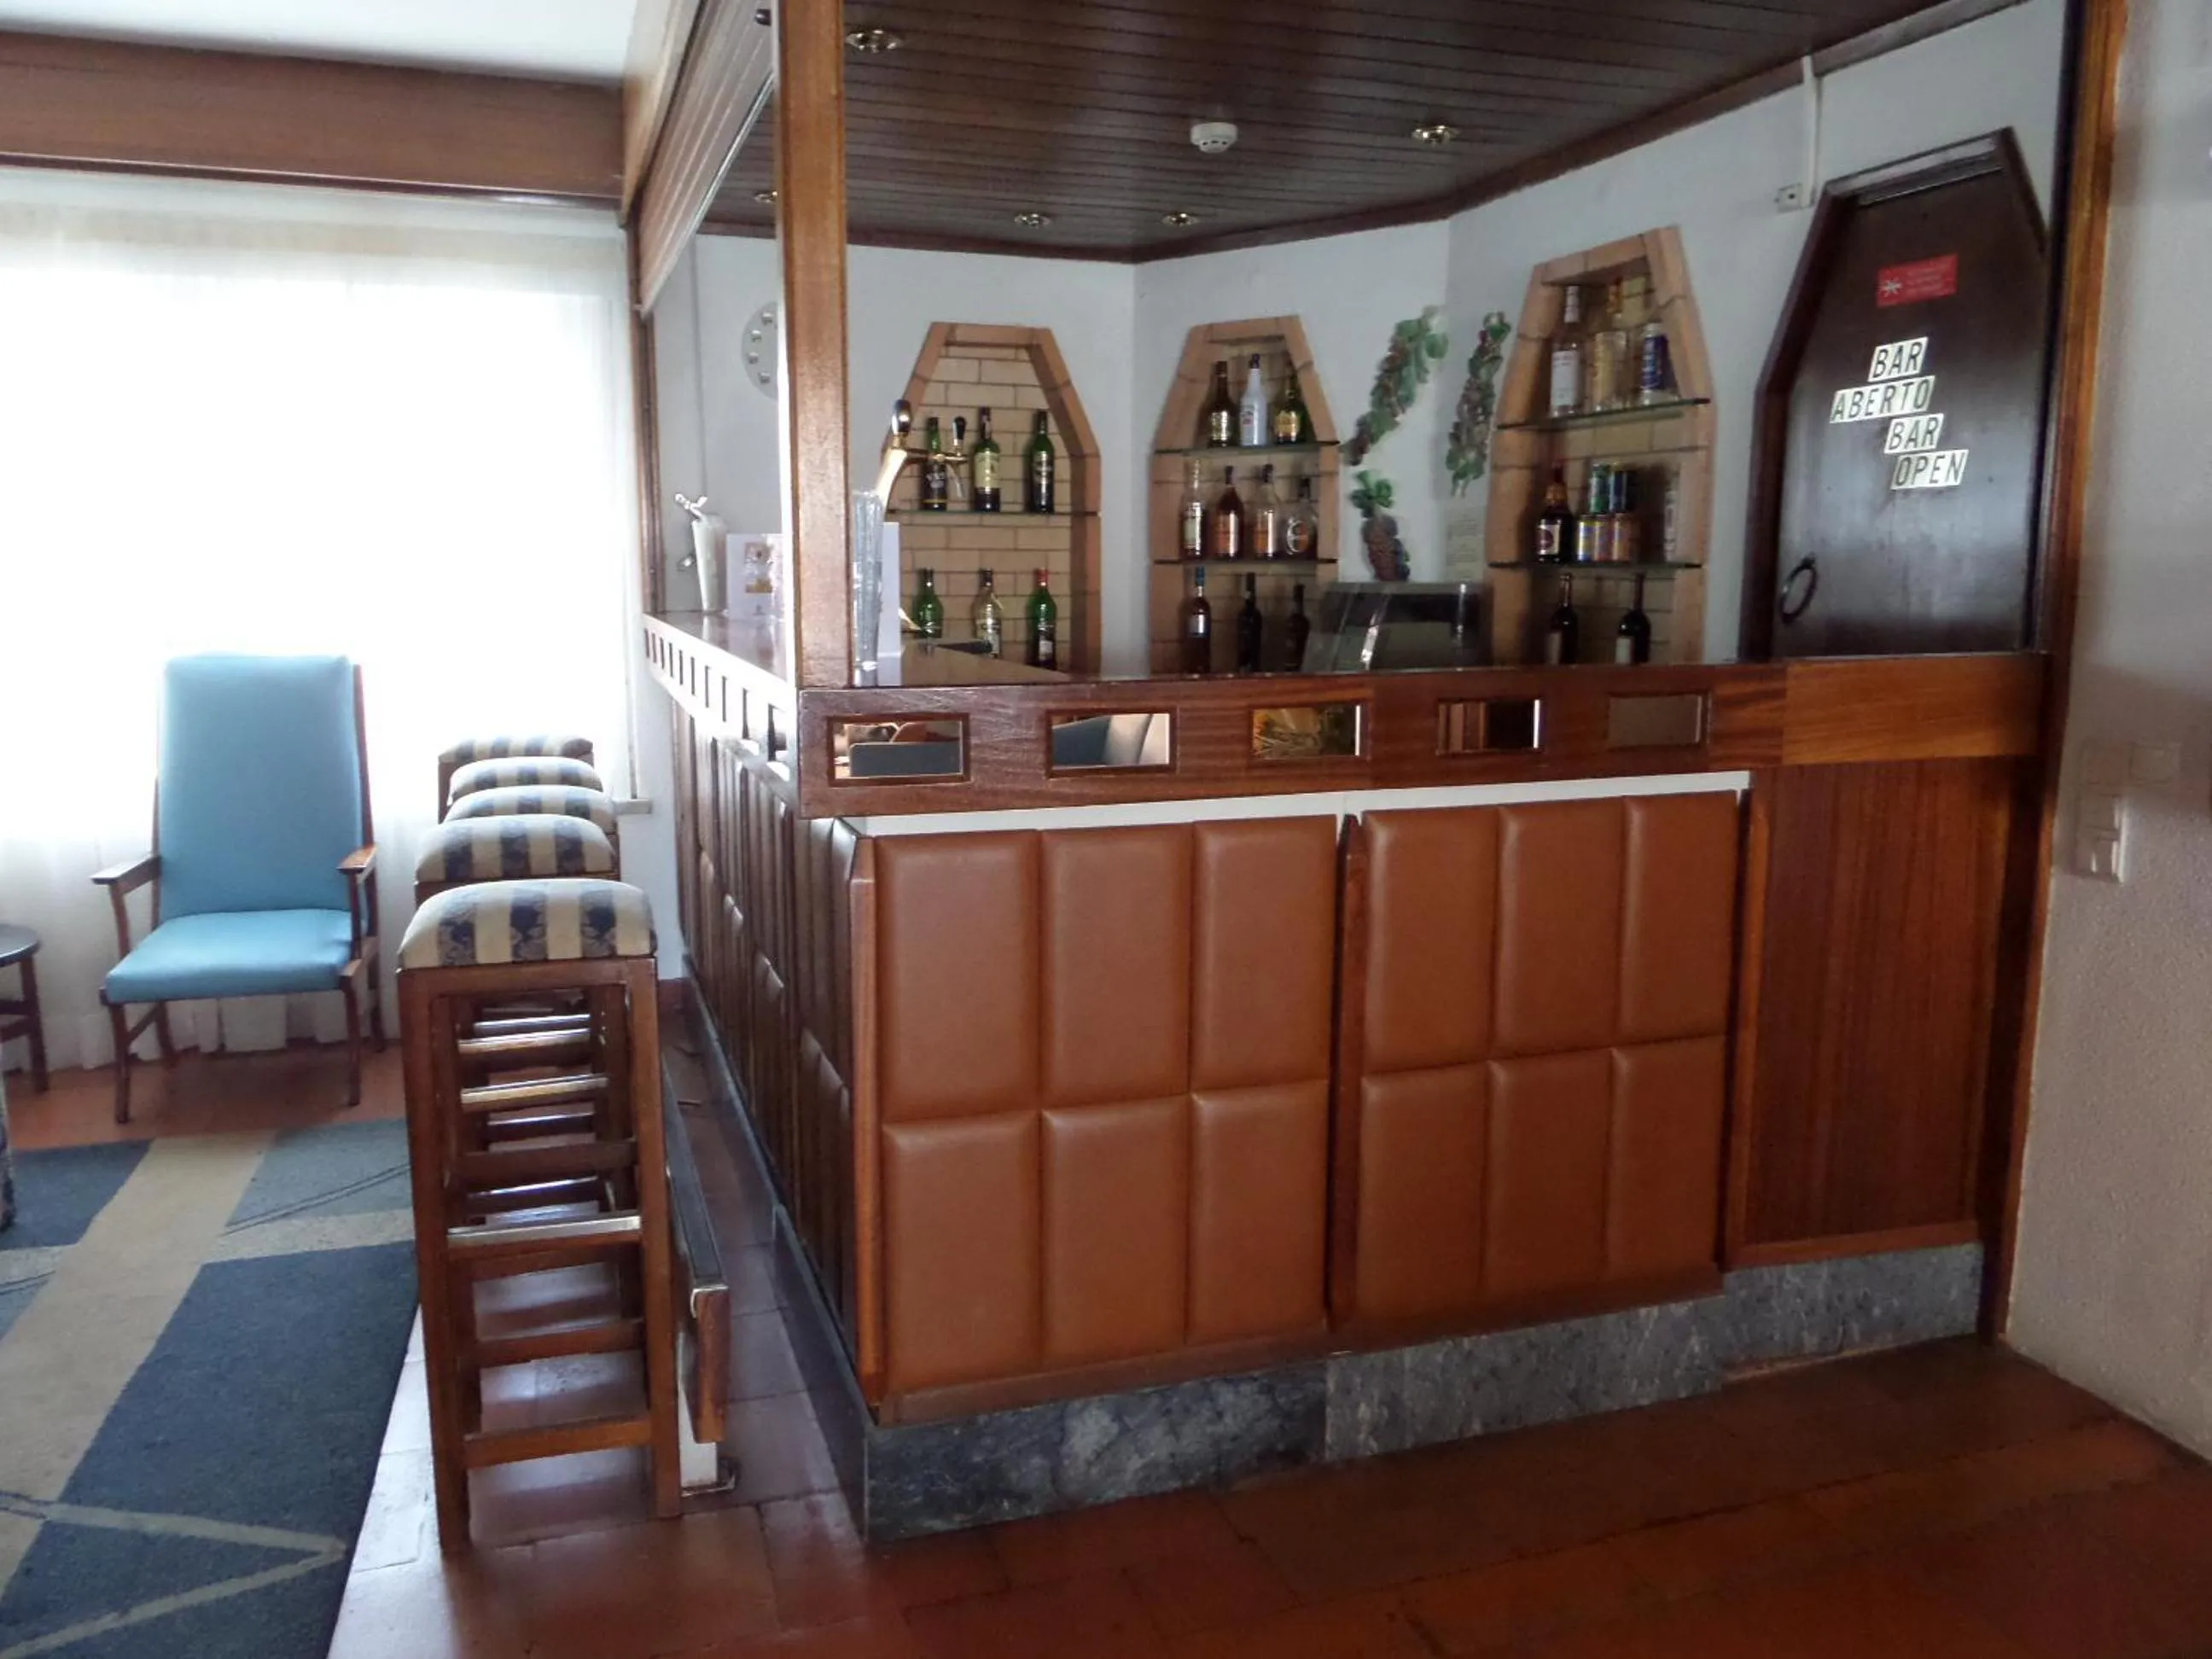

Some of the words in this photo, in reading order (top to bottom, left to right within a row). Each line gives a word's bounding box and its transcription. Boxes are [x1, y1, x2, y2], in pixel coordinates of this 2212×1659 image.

[1872, 341, 1923, 378] BAR
[1832, 379, 1930, 421] ABERTO
[1889, 417, 1939, 451] BAR
[1895, 451, 1965, 486] OPEN
